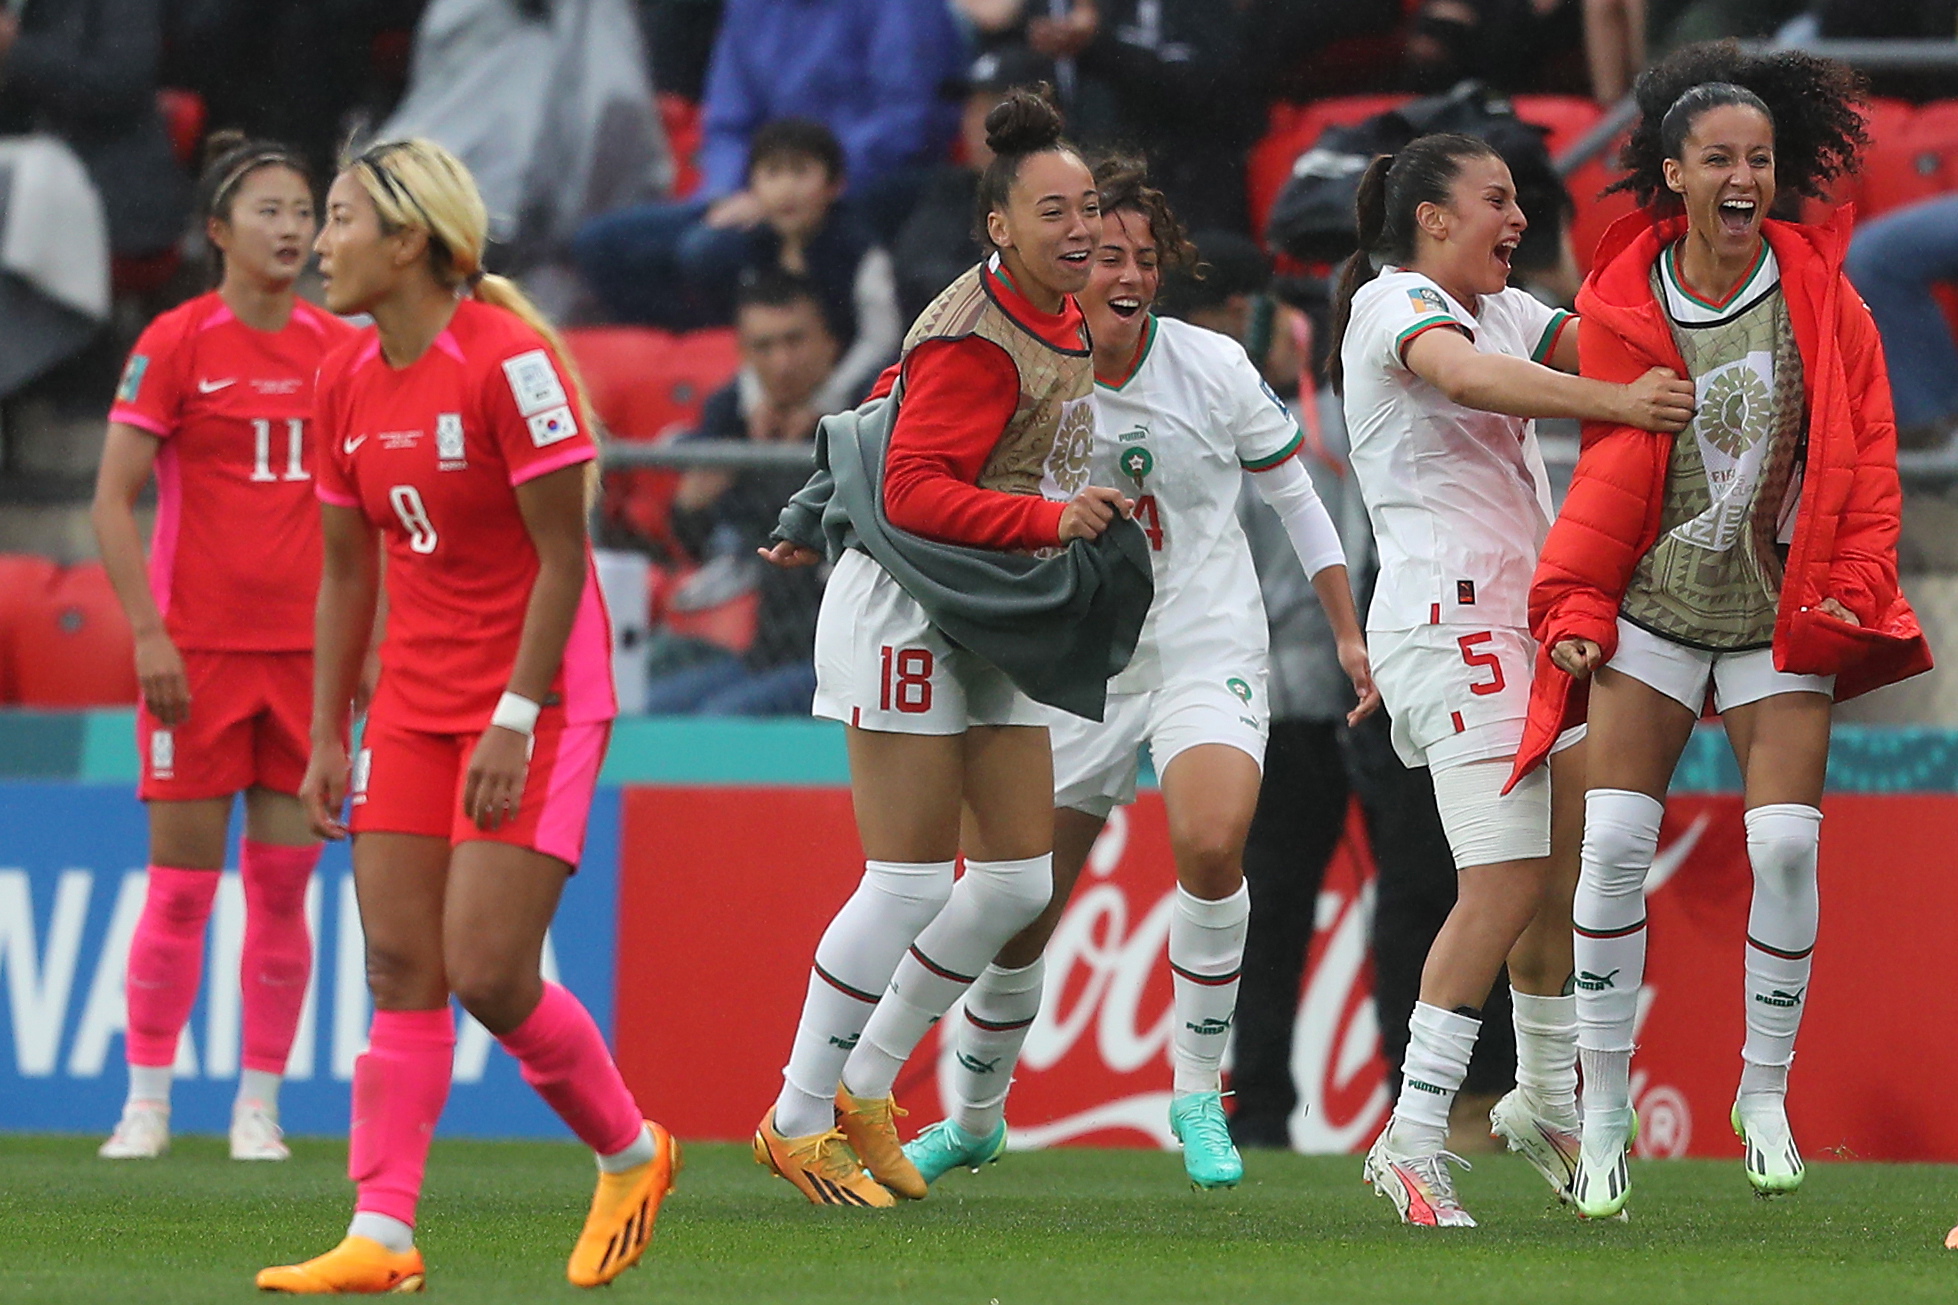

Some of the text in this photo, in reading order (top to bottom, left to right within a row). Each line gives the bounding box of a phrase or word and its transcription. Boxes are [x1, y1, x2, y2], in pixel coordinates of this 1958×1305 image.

[250, 418, 311, 481] 11
[389, 484, 438, 554] 8
[1133, 495, 1163, 551] 4
[880, 645, 934, 713] 18
[1457, 631, 1506, 696] 5
[1186, 1021, 1225, 1035] PUMA
[1755, 993, 1795, 1007] PUMA
